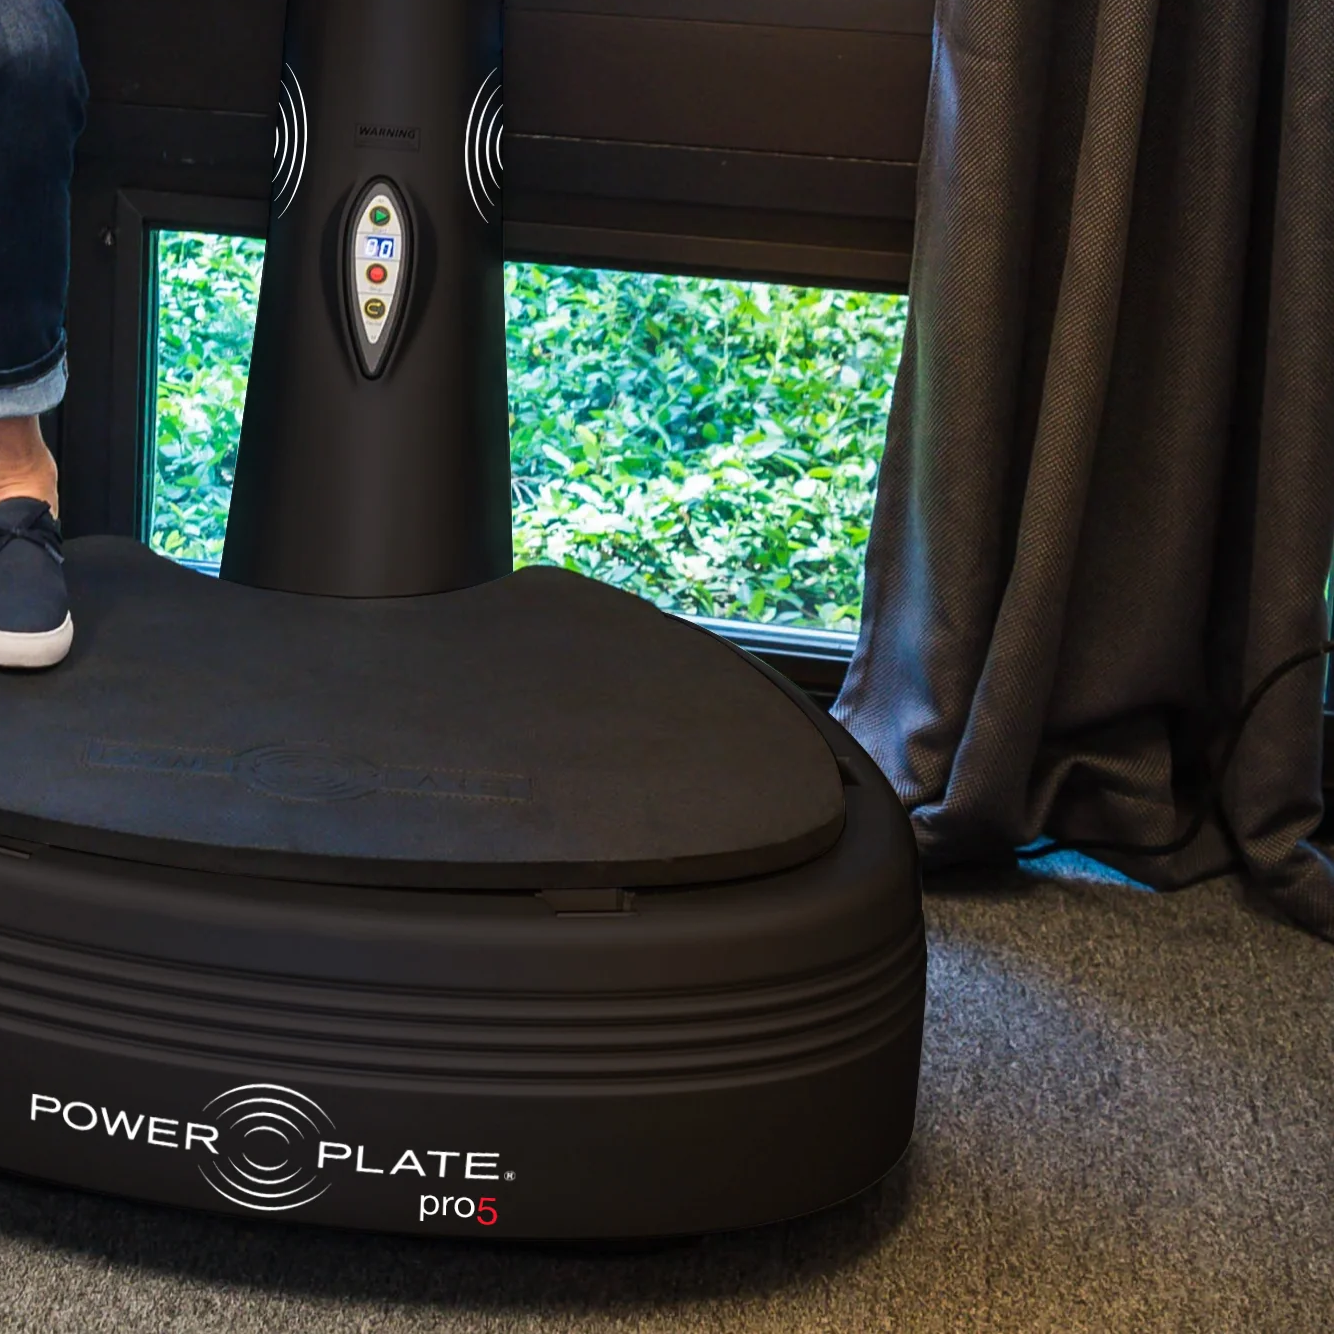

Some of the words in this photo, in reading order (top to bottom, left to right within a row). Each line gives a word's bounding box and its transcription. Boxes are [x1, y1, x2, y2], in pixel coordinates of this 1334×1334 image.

[359, 126, 416, 140] WARNING
[31, 1093, 220, 1155] POWER
[419, 1194, 499, 1226] pro5
